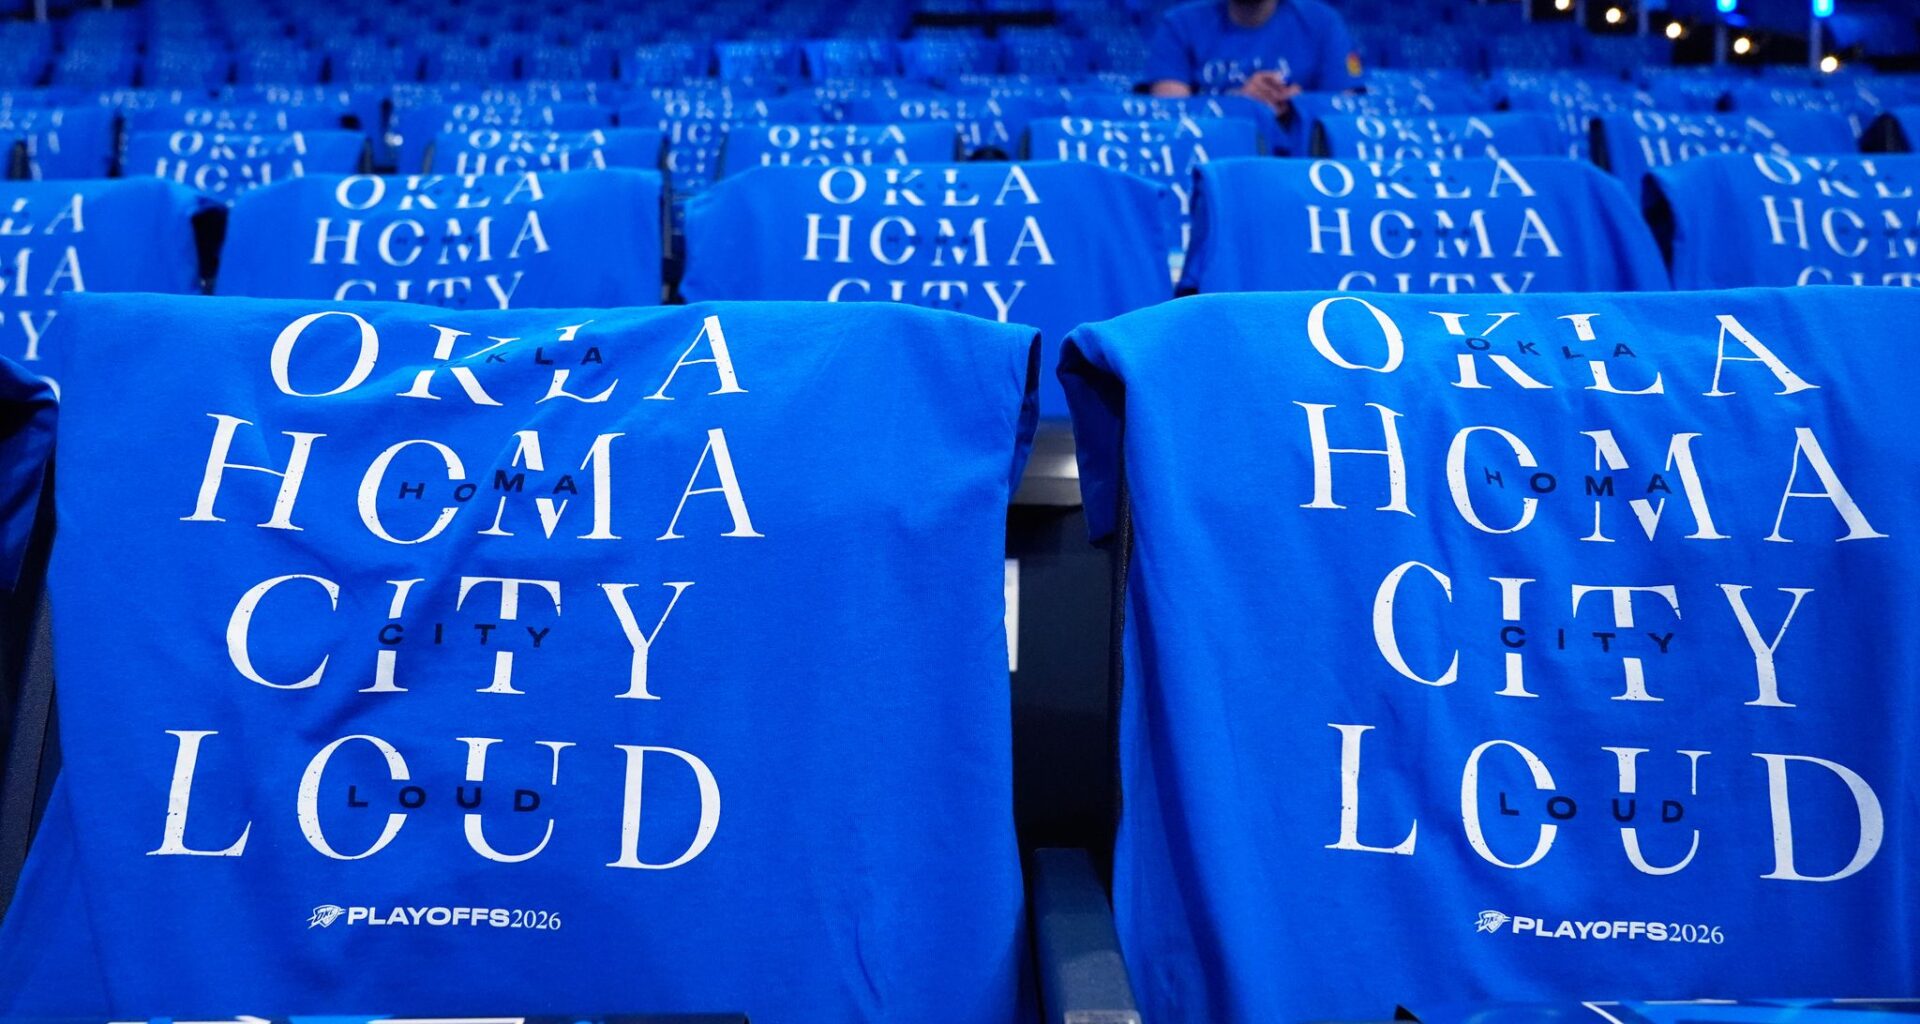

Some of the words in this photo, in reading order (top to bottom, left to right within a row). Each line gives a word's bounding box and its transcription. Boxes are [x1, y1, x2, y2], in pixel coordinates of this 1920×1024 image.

[335, 171, 545, 211] OKLA
[818, 165, 1041, 207] OKLA
[1308, 158, 1536, 200] OKLA
[310, 209, 551, 267] HOMA
[803, 213, 1056, 267] HOMA
[1305, 204, 1562, 260] HOMA
[270, 310, 749, 407] OKLA
[1307, 296, 1821, 397] OKLA
[1465, 337, 1637, 360] OKLA
[179, 412, 766, 545] HOMA
[399, 469, 578, 502] HOMA
[1292, 400, 1890, 543] HOMA
[1484, 467, 1673, 497] HOMA
[225, 573, 696, 700] CITY
[378, 622, 550, 649] CITY
[1372, 560, 1815, 708] CITY
[1500, 626, 1676, 654] CITY
[146, 729, 721, 870] LOUD
[347, 785, 542, 813] LOUD
[1324, 723, 1884, 882] LOUD
[1500, 791, 1685, 825] LOUD
